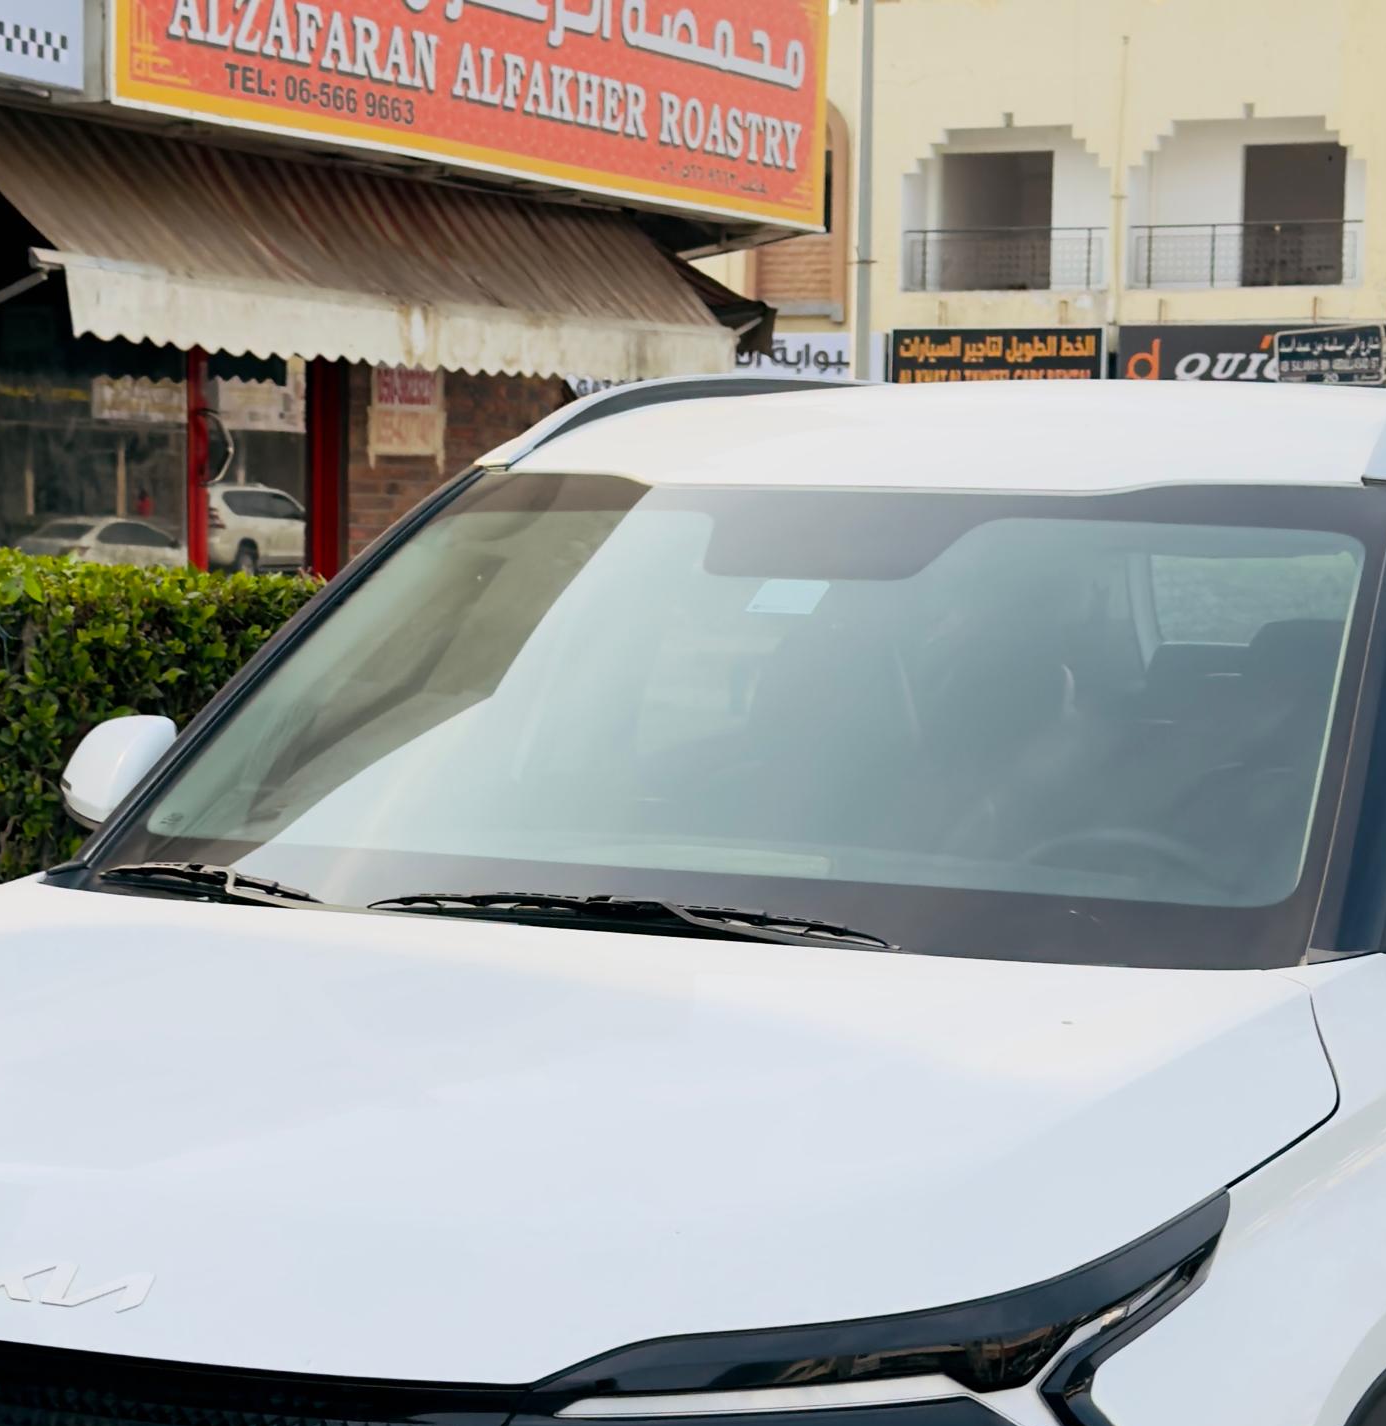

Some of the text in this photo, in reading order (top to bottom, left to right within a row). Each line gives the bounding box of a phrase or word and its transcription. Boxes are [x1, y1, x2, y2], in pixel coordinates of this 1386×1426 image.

[166, 0, 439, 92] ALZAFARAN
[451, 42, 649, 140] ALFAKHER
[658, 91, 803, 171] ROASTRY
[224, 62, 415, 126] TEL: 06-566 9663
[899, 336, 962, 363] السيارات
[1004, 336, 1058, 363] الطويل
[1059, 335, 1096, 358] الخط
